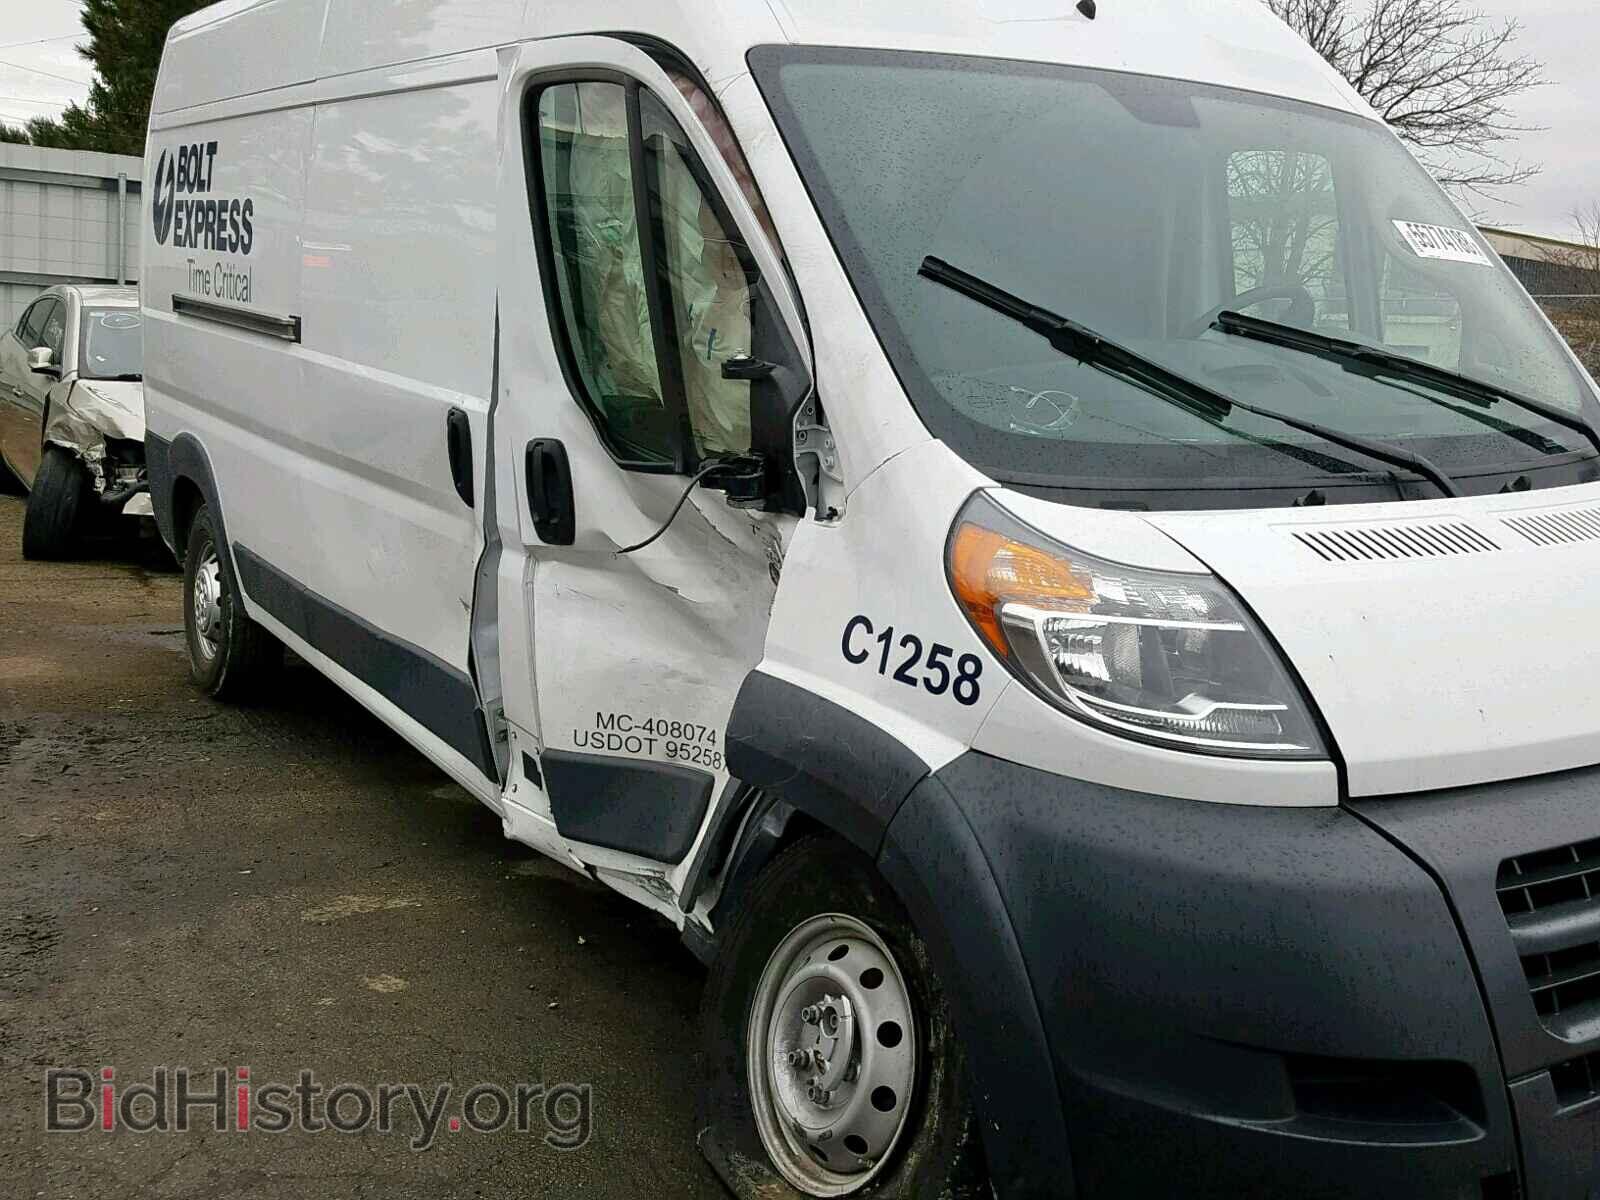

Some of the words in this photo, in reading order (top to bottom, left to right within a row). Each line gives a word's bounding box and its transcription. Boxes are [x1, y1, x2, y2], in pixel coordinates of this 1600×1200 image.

[176, 141, 218, 194] BOLT
[173, 198, 254, 255] EXPRESS
[187, 258, 211, 297] Time
[213, 262, 252, 303] Critical
[841, 614, 983, 706] C1258
[573, 729, 658, 755] USDOT
[665, 740, 727, 772] 95258
[596, 711, 717, 746] MC-408074
